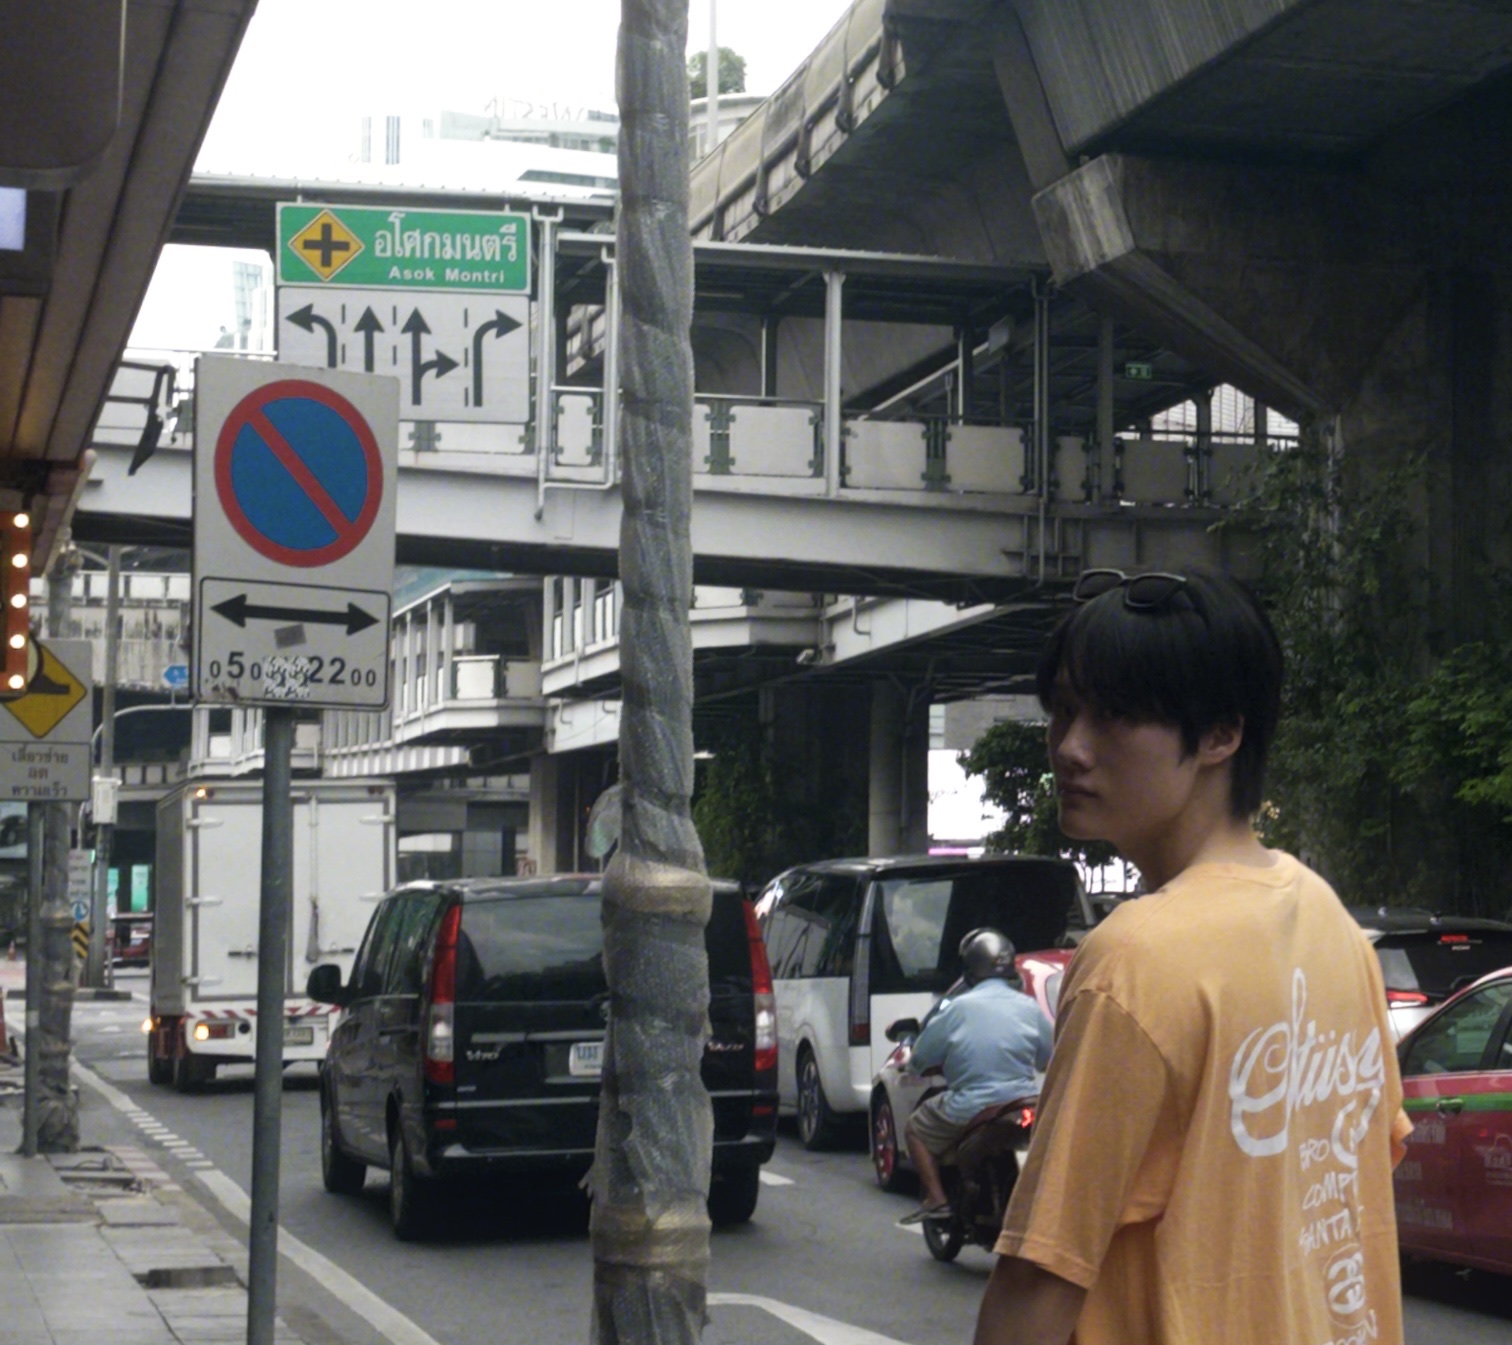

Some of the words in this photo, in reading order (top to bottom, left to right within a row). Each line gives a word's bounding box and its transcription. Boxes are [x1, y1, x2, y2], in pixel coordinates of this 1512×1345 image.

[374, 212, 517, 263] อโศกมนตรี
[388, 266, 435, 281] Asok
[445, 268, 505, 284] Montri
